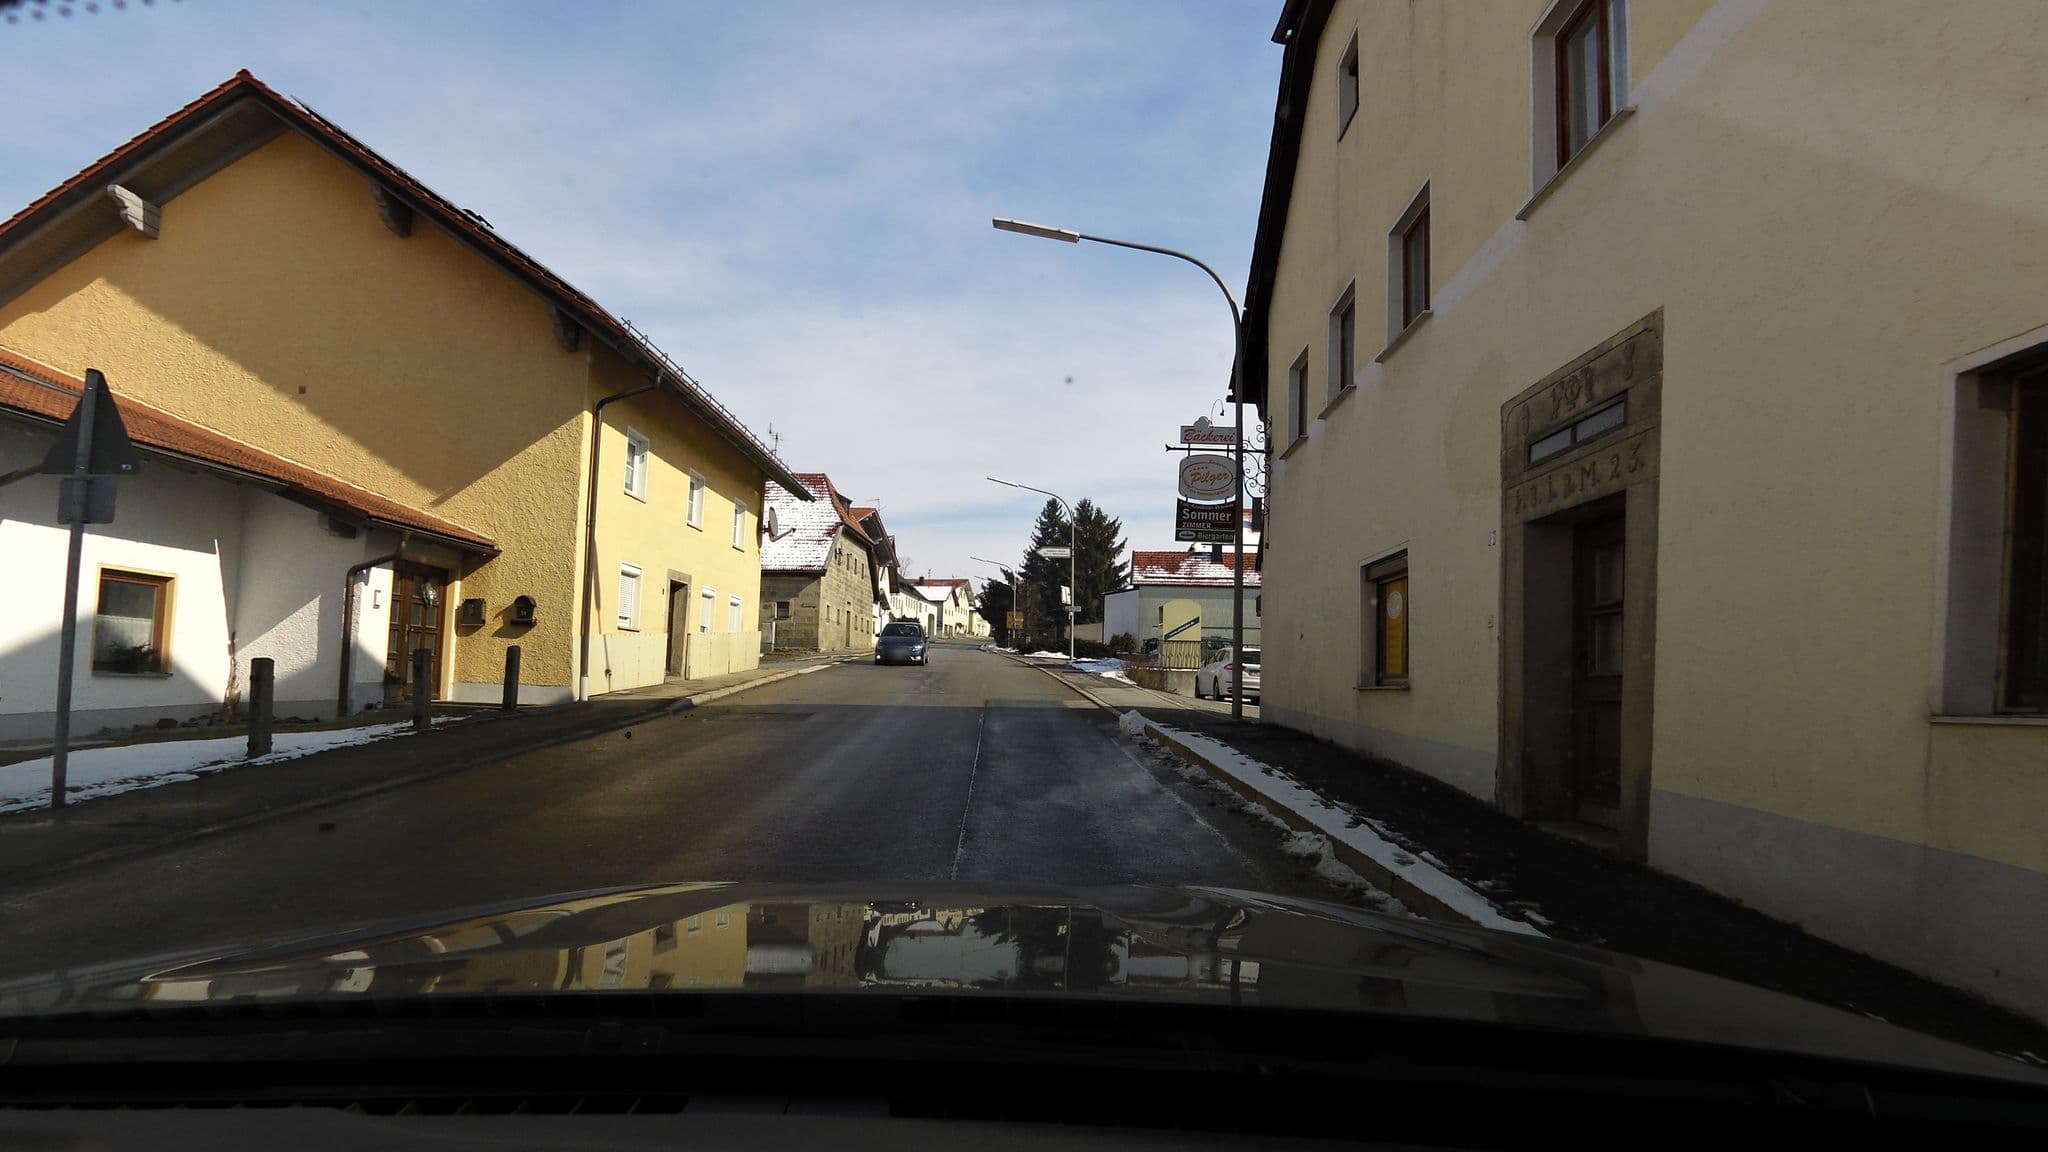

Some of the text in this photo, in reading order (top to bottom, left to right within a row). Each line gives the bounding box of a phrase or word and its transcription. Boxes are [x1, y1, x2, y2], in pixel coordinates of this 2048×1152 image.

[1183, 428, 1235, 442] Bäckerei
[1190, 471, 1229, 485] Pilger
[1182, 508, 1232, 522] Sommer
